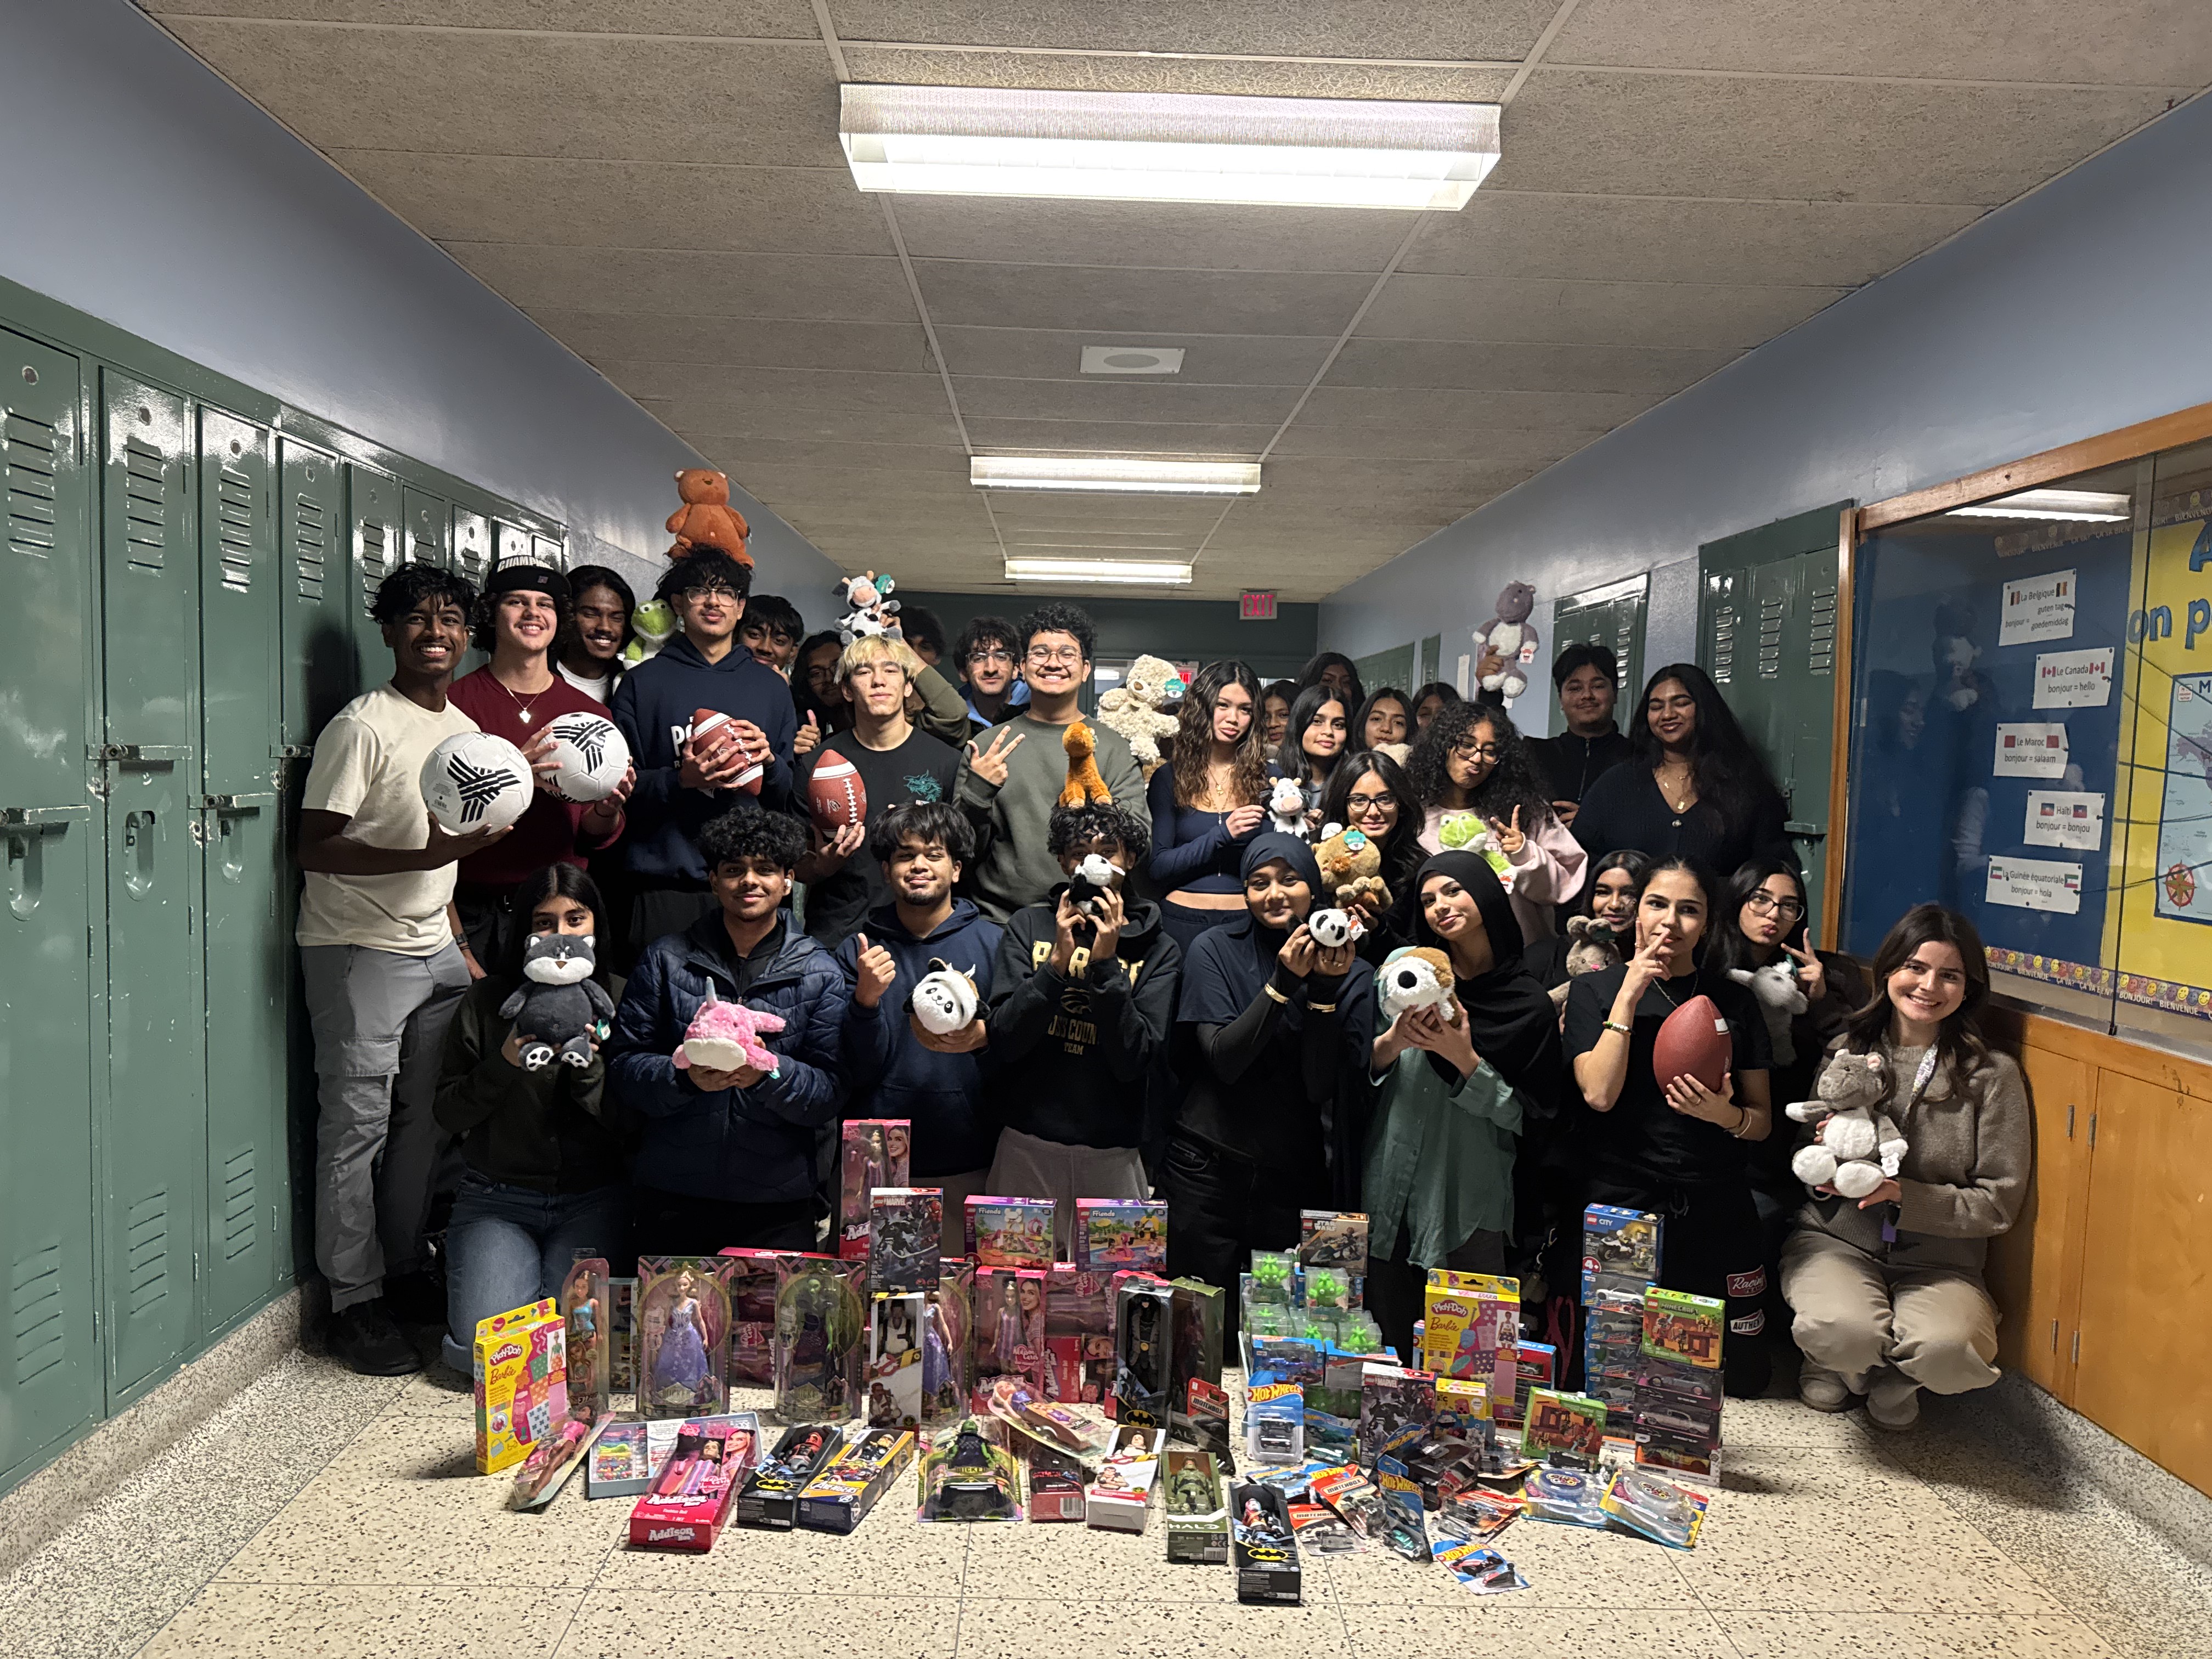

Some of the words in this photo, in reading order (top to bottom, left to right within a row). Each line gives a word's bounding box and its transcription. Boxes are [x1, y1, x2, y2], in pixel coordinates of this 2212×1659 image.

[2175, 507, 2212, 522] BIENVENU
[2021, 593, 2027, 602] La
[2029, 589, 2055, 600] Belgique
[1243, 595, 1275, 617] EXIT
[2038, 604, 2054, 614] guten
[2005, 618, 2025, 628] bonjour
[2031, 617, 2069, 631] goedemiddag
[2128, 605, 2171, 644] on
[2057, 667, 2064, 675] Le
[2065, 665, 2089, 675] Canada
[2048, 684, 2073, 694] bonjour
[2079, 681, 2095, 691] hello
[2017, 738, 2024, 747] Le
[2025, 738, 2045, 746] Maroc
[2005, 754, 2028, 763] bonjour
[2034, 754, 2056, 763] salaam
[2056, 806, 2072, 815] Haïti
[2036, 821, 2061, 831] bonjour
[2068, 823, 2090, 833] bonjou
[2002, 870, 2009, 878] La
[2010, 870, 2030, 880] Guinée
[2031, 872, 2064, 885] équatoriale
[2011, 884, 2033, 896] bonjour
[2039, 889, 2052, 898] hola
[2119, 991, 2153, 1006] BONJOUR!
[2159, 999, 2202, 1016] BIENVENUE.
[1068, 1019, 1097, 1045] COUN
[1064, 1042, 1084, 1055] TEAM
[886, 1198, 906, 1206] MARVEL
[1584, 1260, 1599, 1269] 4+
[1432, 1302, 1467, 1316] Play-Doh
[1661, 1303, 1700, 1316] MINECRAFT
[1430, 1317, 1459, 1331] Barbie
[490, 1344, 522, 1364] Play-Doh
[490, 1365, 516, 1385] Barbie
[1044, 1348, 1059, 1397] Addison
[1377, 1378, 1397, 1388] MARVEL
[1251, 1387, 1271, 1402] HOT
[1269, 1384, 1301, 1400] WHEELS
[1193, 1397, 1223, 1415] MATCHBOX
[1310, 1469, 1325, 1480] HOT
[1381, 1472, 1398, 1490] HOT
[810, 1481, 860, 1493] AVENGERS
[1327, 1479, 1362, 1493] MATCHBOX
[646, 1493, 708, 1505] Addison
[648, 1527, 695, 1542] Addison
[1444, 1549, 1462, 1561] HOT
